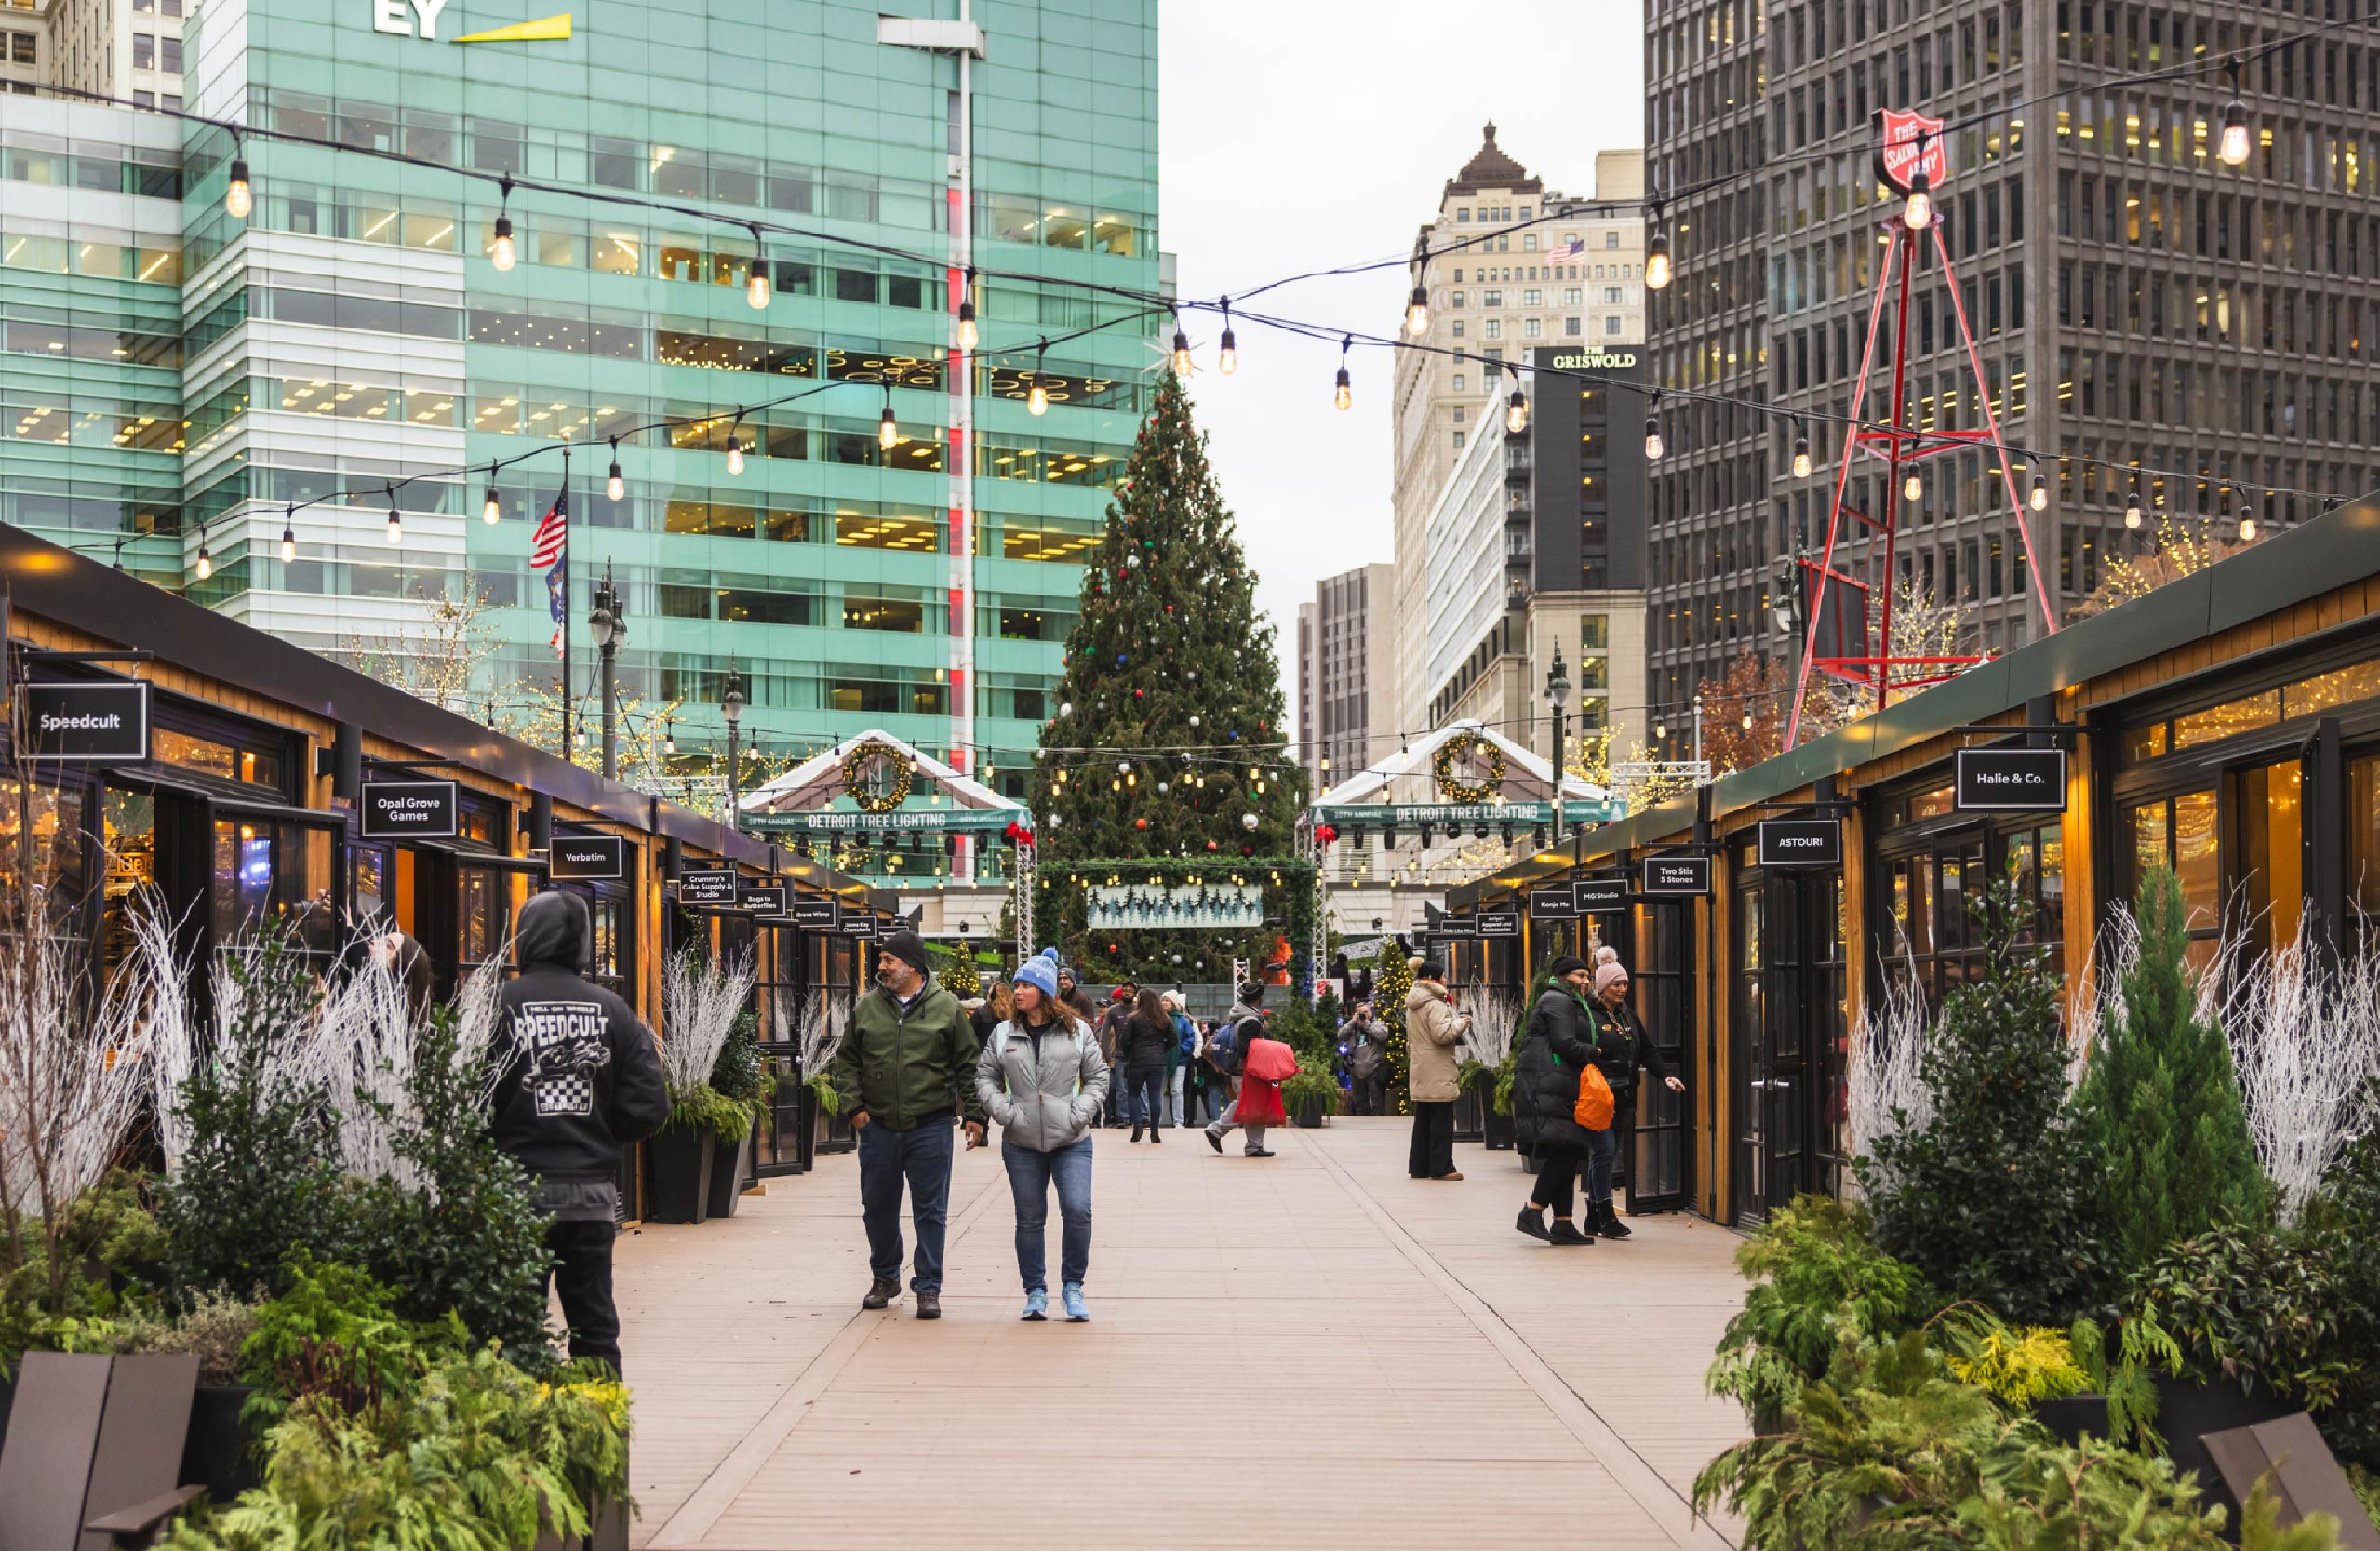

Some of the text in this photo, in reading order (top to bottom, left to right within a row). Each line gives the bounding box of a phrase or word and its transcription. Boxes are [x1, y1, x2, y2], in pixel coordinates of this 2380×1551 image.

[373, 0, 448, 40] EY
[1894, 120, 1918, 142] THE
[1553, 354, 1637, 368] GRISWOLD
[40, 714, 121, 731] Speedcult
[1977, 773, 2045, 783] Halie & Co.
[378, 797, 440, 810] Opal Grove
[389, 810, 429, 821] Games
[1396, 804, 1538, 821] DETROIT TREE LIGHTING
[809, 813, 946, 828] DETROIT TREE LIGHTING
[1778, 837, 1823, 847] ASTOURI
[566, 852, 607, 862] Verbatim
[701, 883, 726, 892] Supply
[515, 1014, 609, 1051] SPEEDCULT
